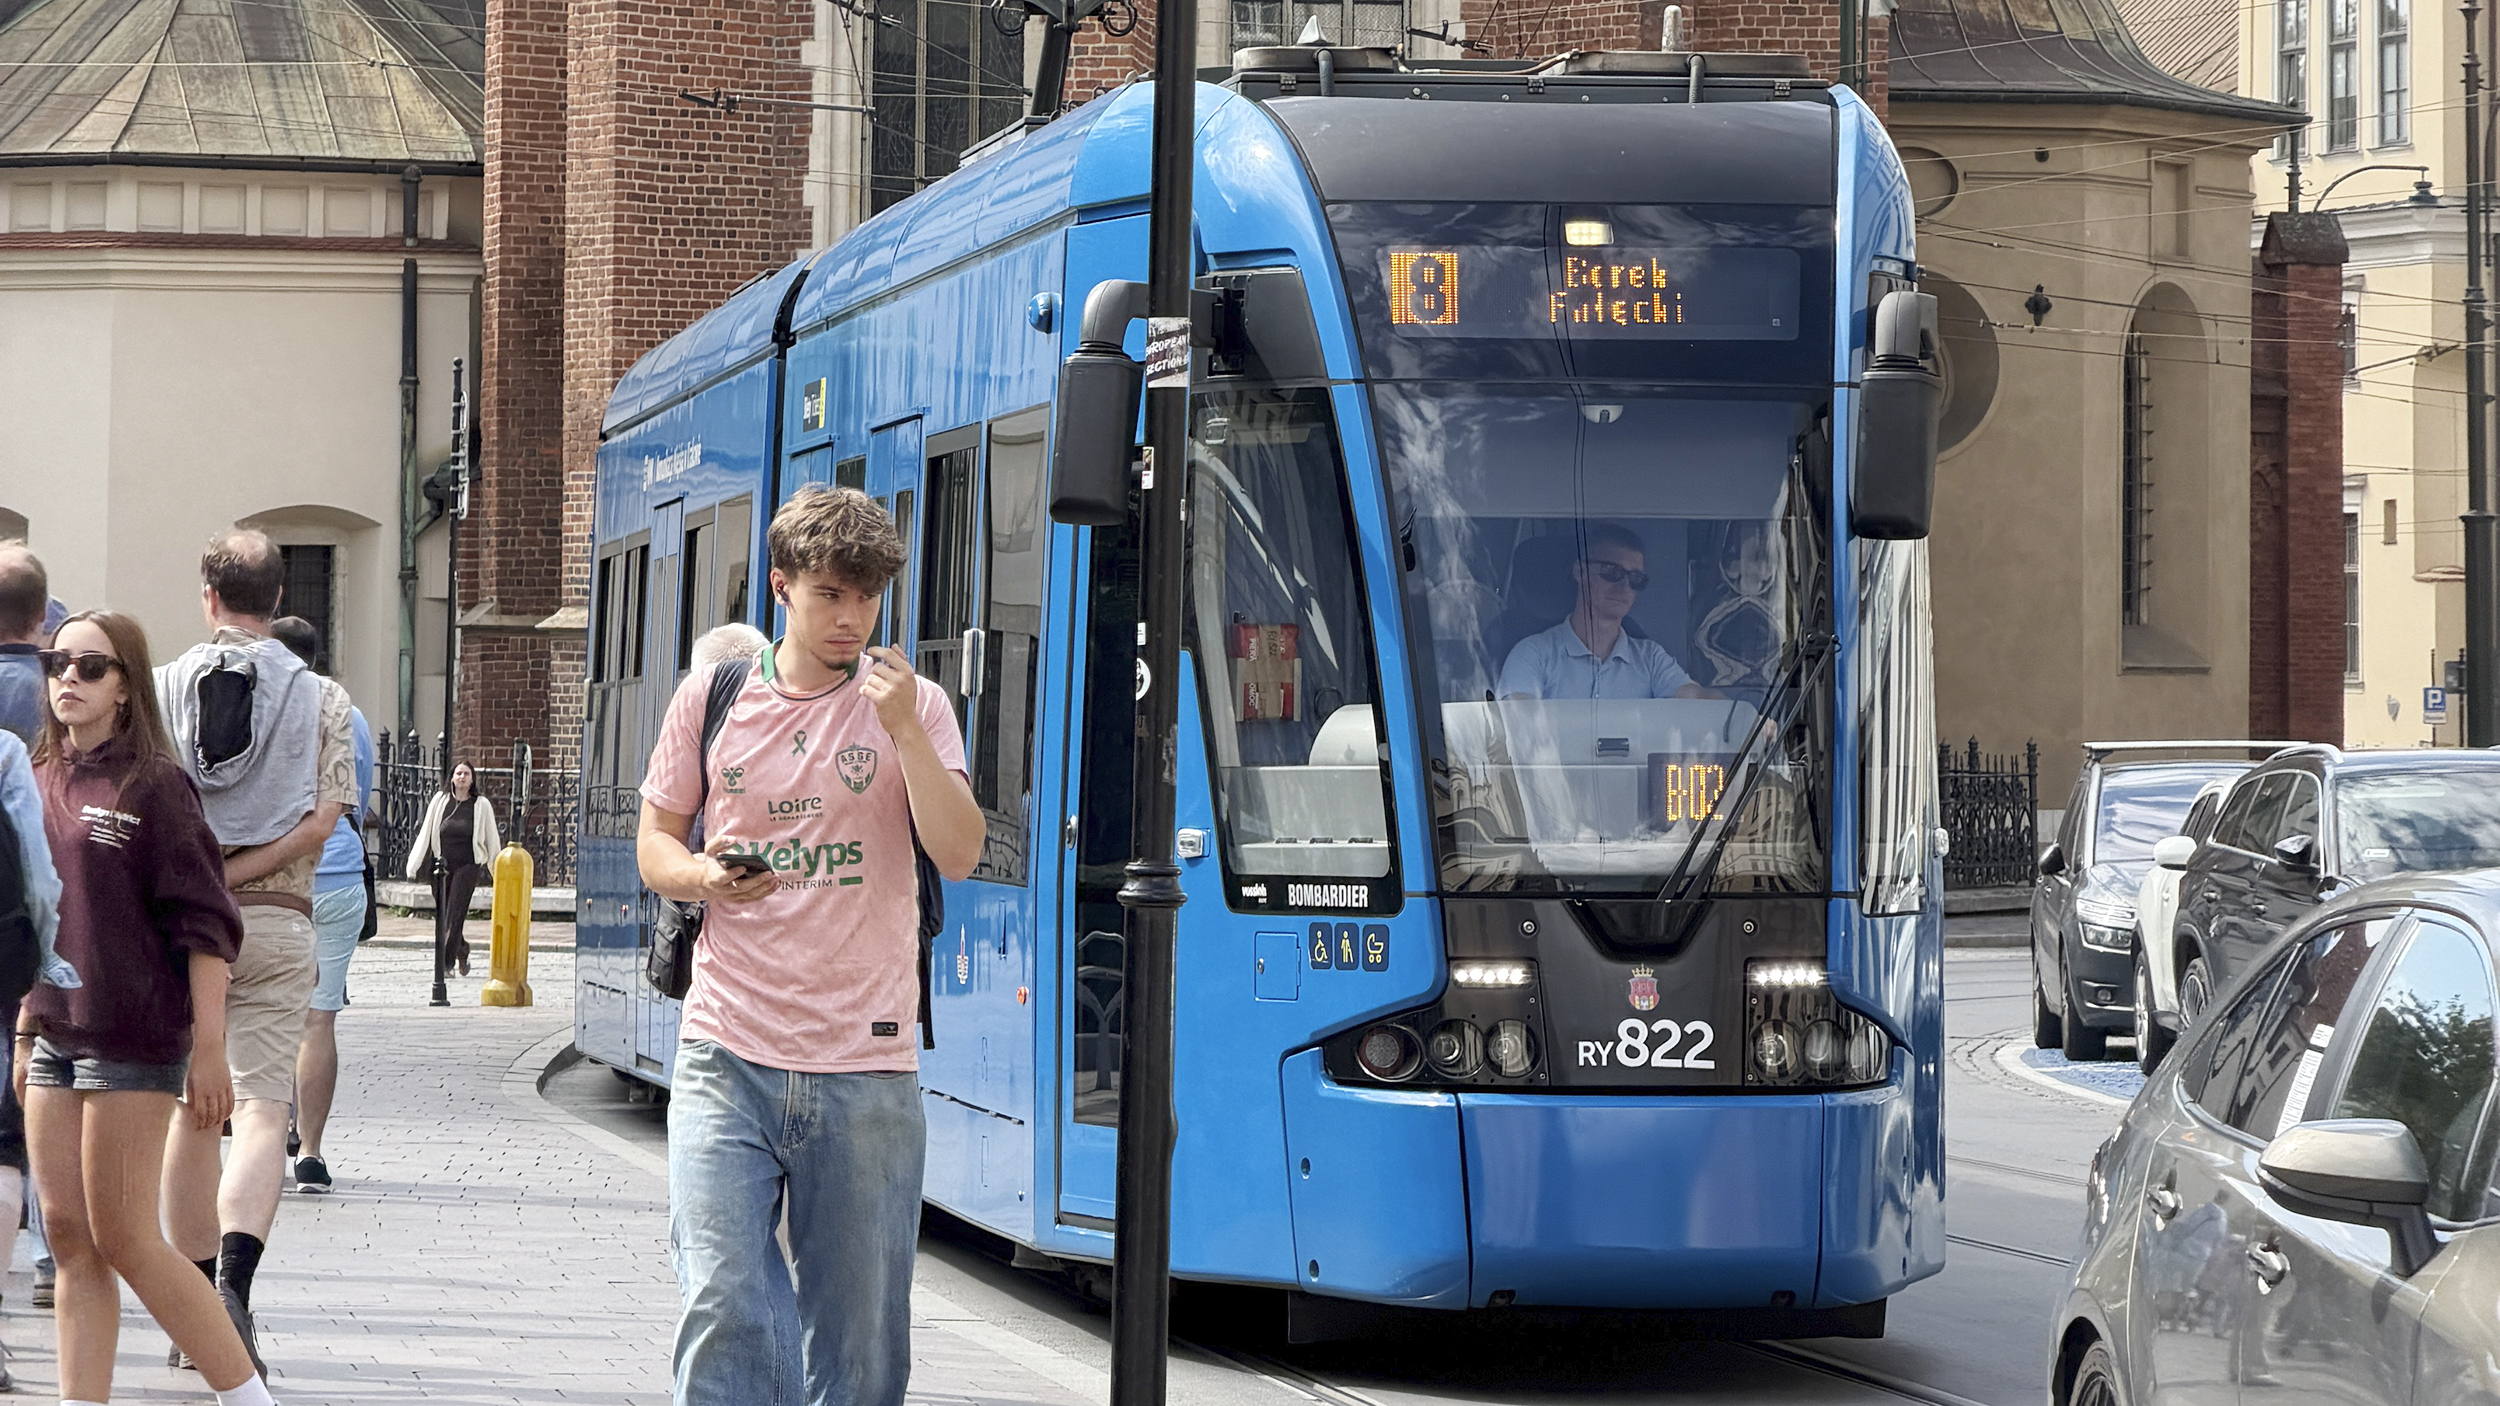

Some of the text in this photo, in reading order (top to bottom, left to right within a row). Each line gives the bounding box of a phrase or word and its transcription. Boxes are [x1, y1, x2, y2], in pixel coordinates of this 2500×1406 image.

[1400, 253, 1452, 324] 8
[2427, 689, 2442, 709] P
[768, 796, 822, 815] Loire
[1287, 883, 1369, 908] BOMBARDIER
